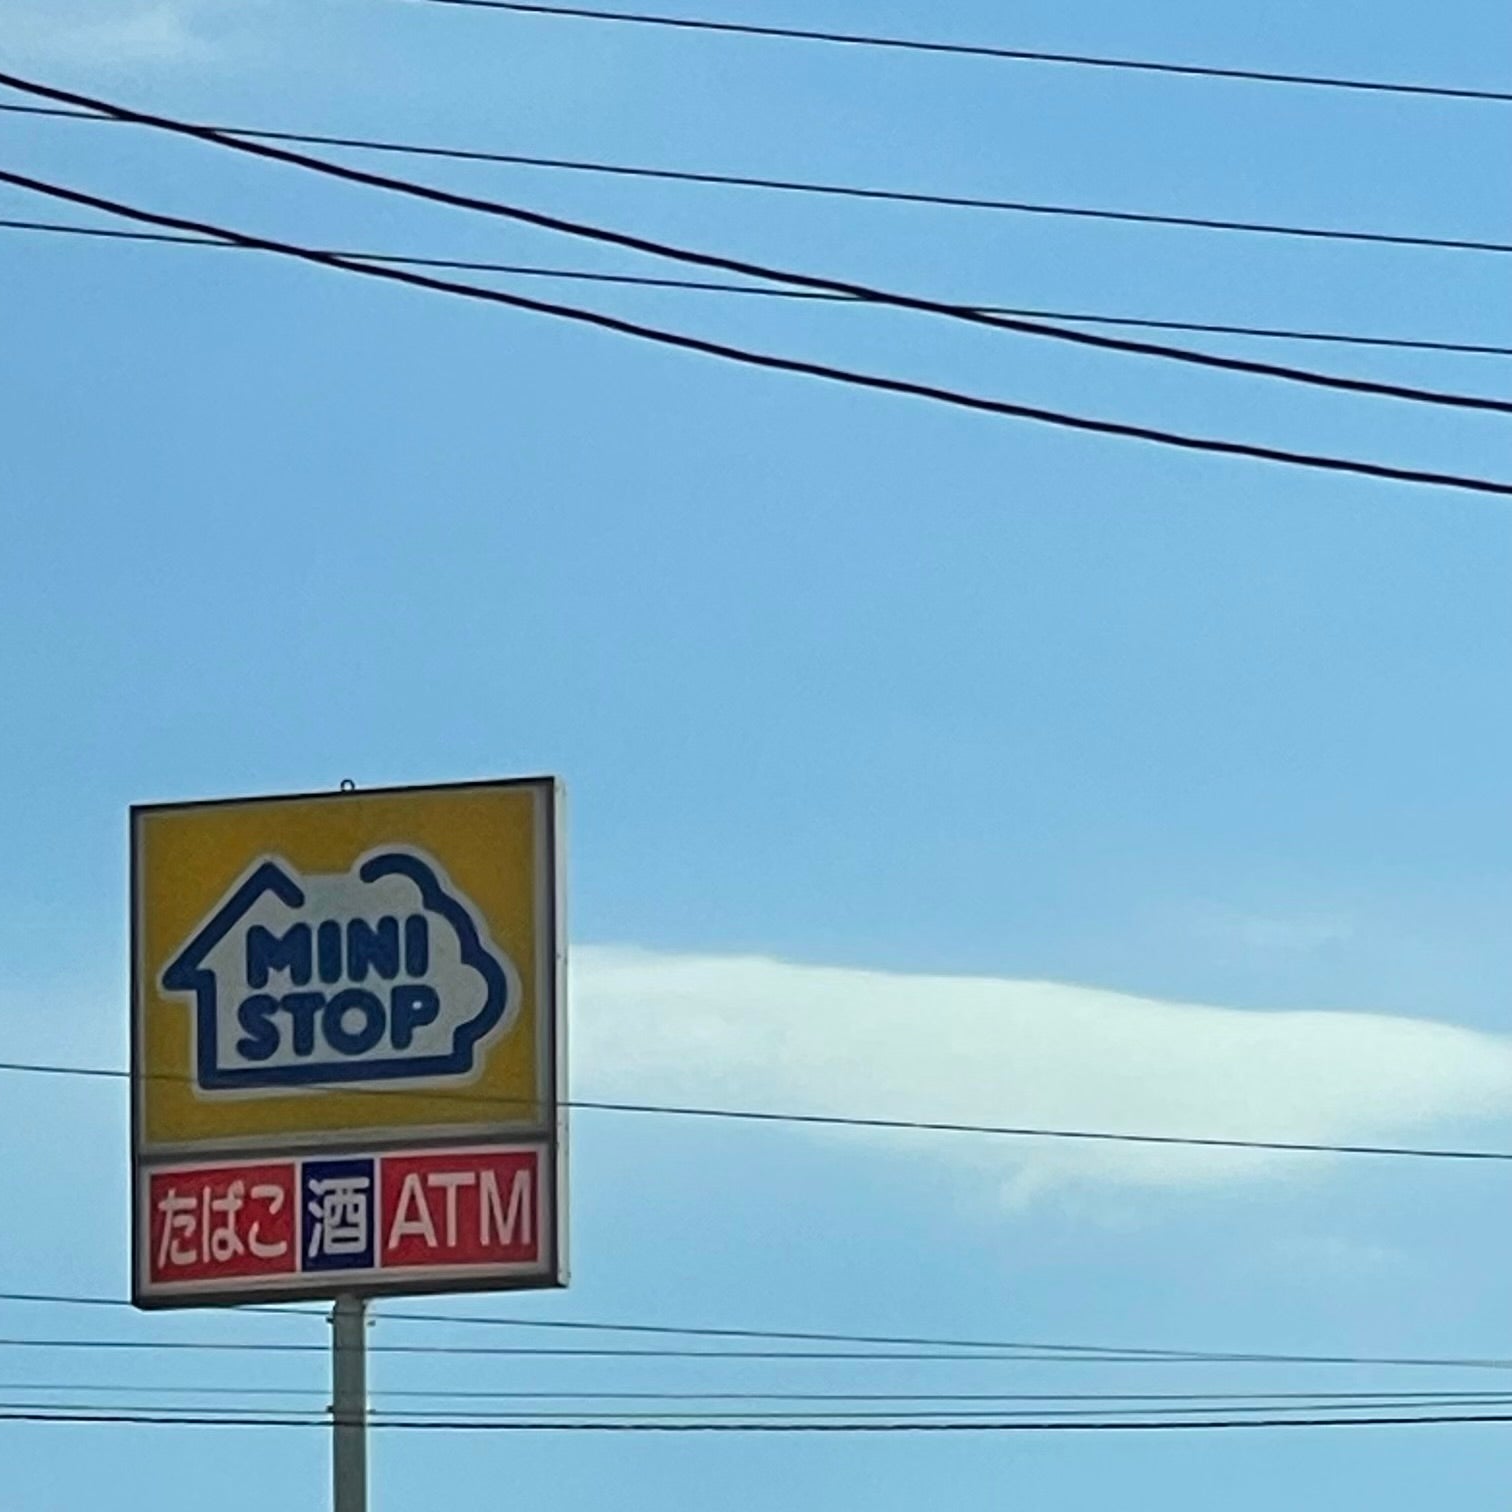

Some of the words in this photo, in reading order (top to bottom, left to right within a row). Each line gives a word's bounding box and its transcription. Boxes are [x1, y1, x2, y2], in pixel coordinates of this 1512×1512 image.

[246, 913, 429, 989] MINI
[236, 984, 441, 1061] STOP
[157, 1179, 288, 1269] たばこ
[307, 1175, 370, 1259] 酒
[388, 1168, 532, 1250] ATM
